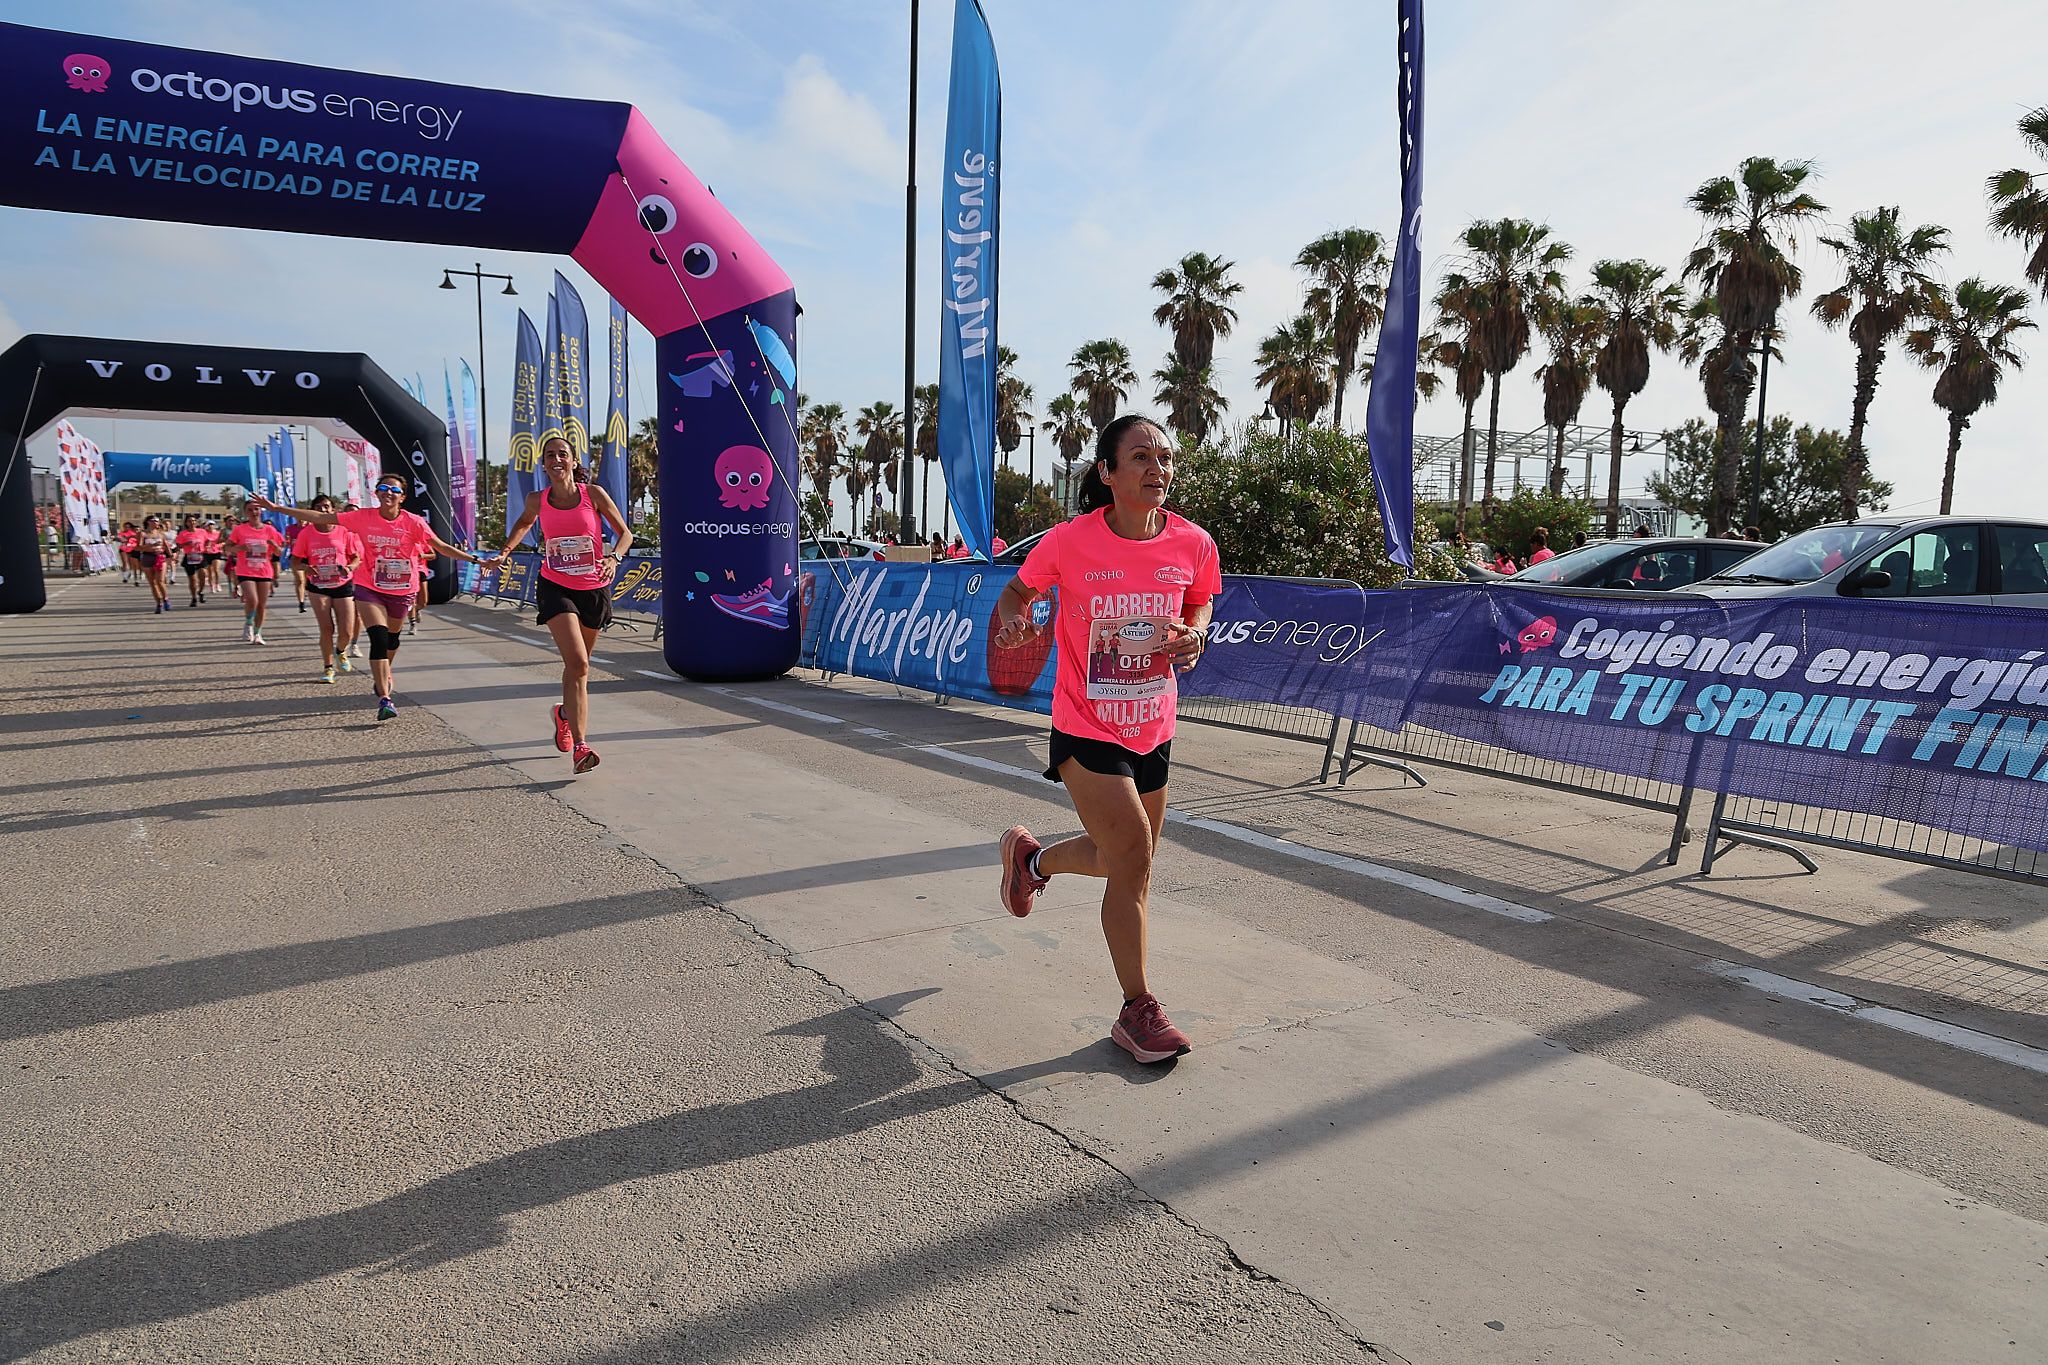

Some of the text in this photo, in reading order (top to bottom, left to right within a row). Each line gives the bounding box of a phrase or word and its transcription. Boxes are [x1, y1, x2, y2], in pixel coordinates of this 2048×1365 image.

[130, 67, 463, 142] octopus energy
[36, 109, 480, 182] LA ENERGÍA PARA CORRER
[34, 147, 486, 213] A LA VELOCIDAD DE LA LUZ
[86, 358, 321, 390] VOLVO
[151, 457, 212, 480] Marlene
[685, 521, 793, 538] octopus energy
[562, 553, 581, 562] 016
[1085, 570, 1124, 582] OYSHO
[1091, 592, 1175, 619] CARRERA
[829, 568, 973, 681] Marlene
[1252, 620, 1386, 664] energy
[1119, 654, 1152, 669] 016
[1559, 617, 2048, 711] Cogiendo energía
[1098, 687, 1128, 695] OYSHO
[1097, 697, 1161, 726] MUJER
[1478, 664, 1602, 717] PARA
[1608, 672, 1685, 727] TU
[1684, 683, 1918, 755] SPRINT
